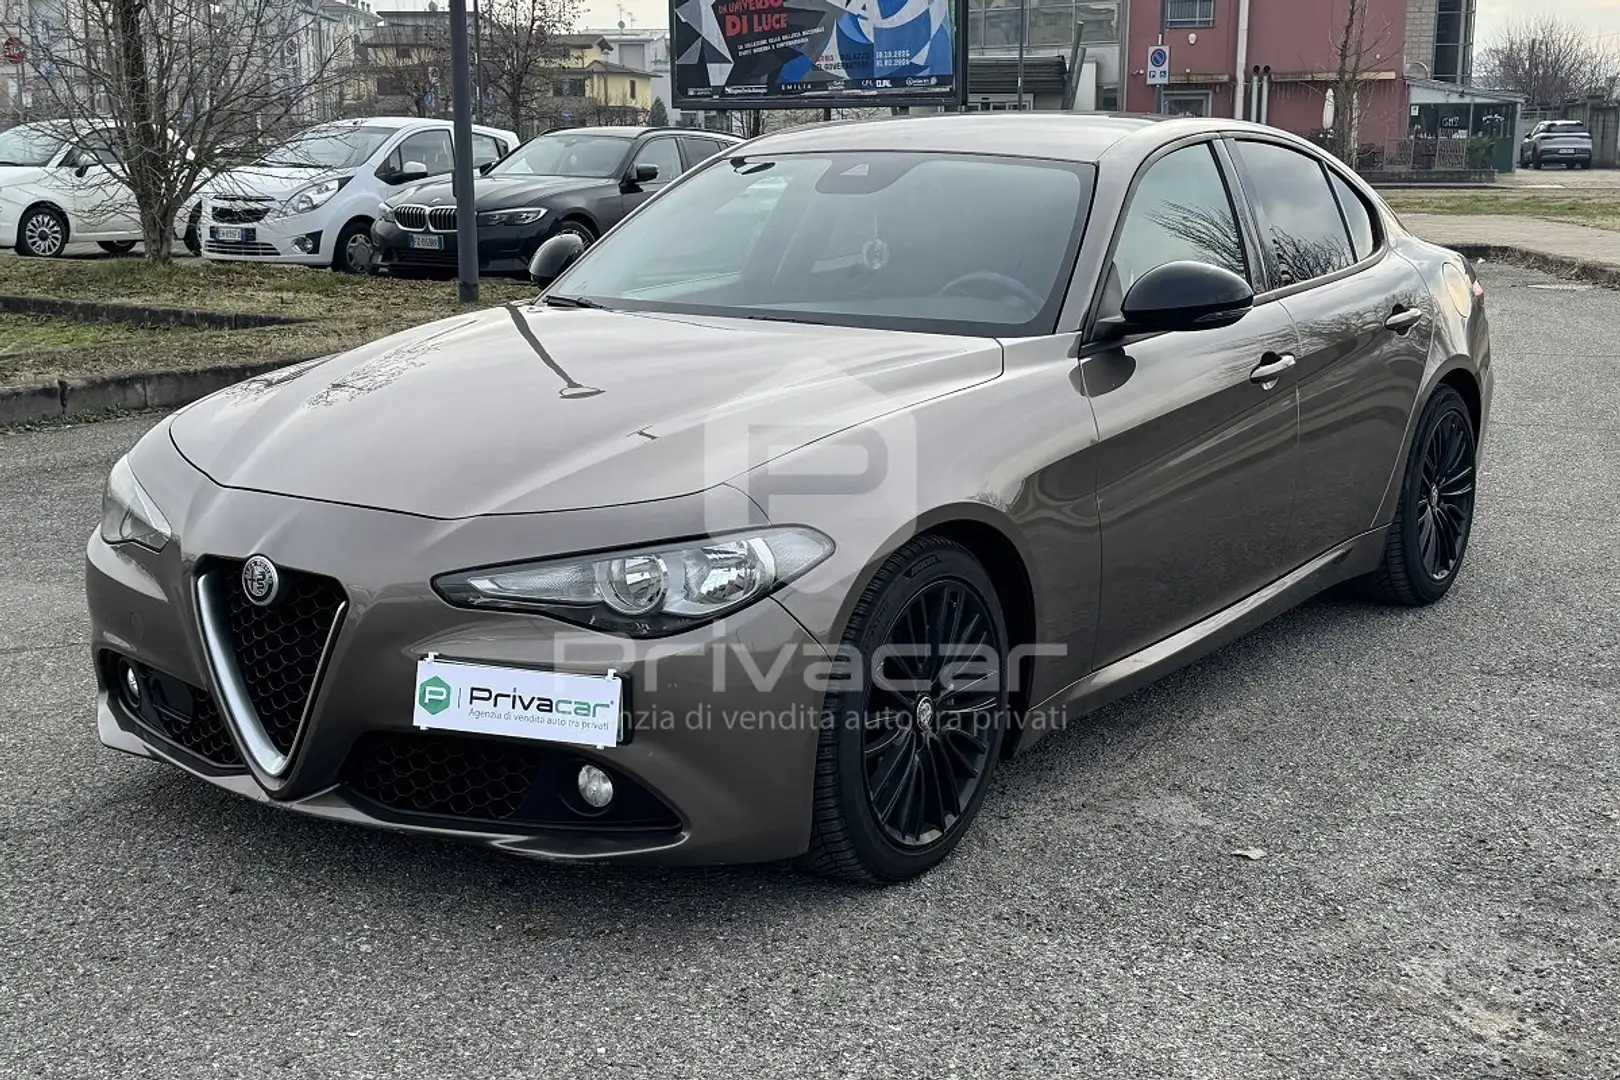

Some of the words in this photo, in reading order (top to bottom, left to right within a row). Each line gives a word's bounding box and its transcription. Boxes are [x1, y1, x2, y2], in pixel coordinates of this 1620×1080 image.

[725, 15, 748, 36] DI
[753, 12, 788, 32] LUCE
[469, 686, 611, 718] Privacar
[469, 708, 501, 720] Agenzia
[504, 711, 512, 720] di
[513, 712, 544, 724] vendita
[547, 717, 566, 726] auto
[568, 719, 579, 728] tra
[582, 721, 609, 731] privati
